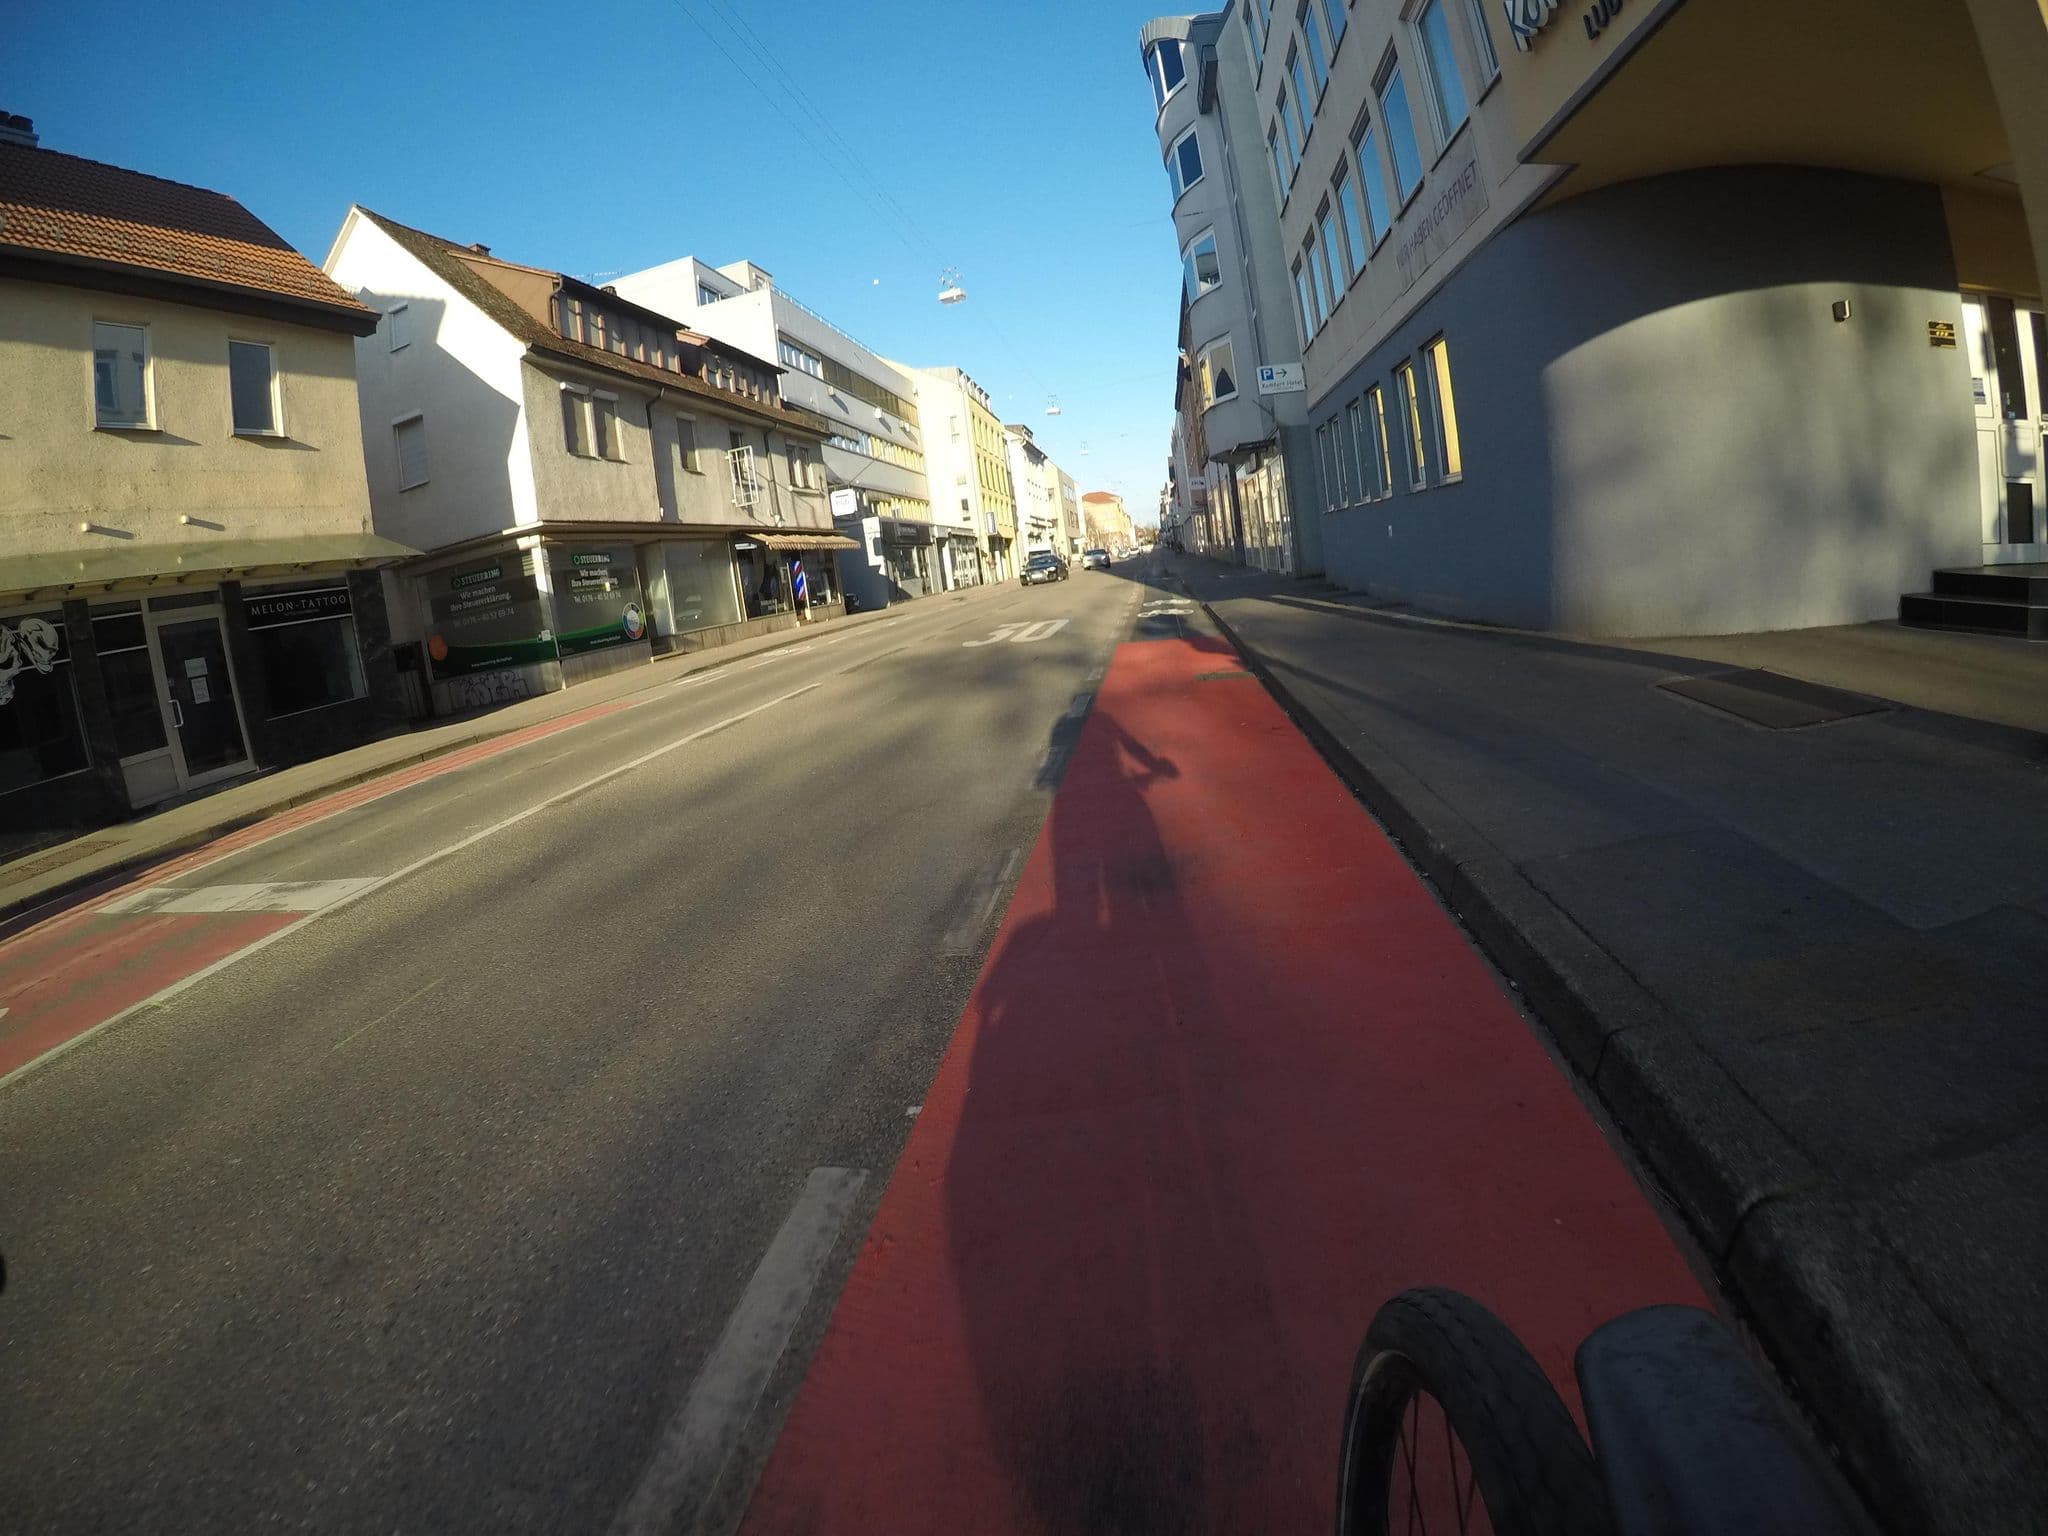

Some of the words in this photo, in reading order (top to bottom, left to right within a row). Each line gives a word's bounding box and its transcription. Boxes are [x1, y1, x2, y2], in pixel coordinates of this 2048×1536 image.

[1409, 215, 1434, 255] HABEN
[1433, 160, 1476, 226] GEÖFFNET
[1263, 369, 1271, 380] P
[461, 568, 501, 586] STEUERRING
[460, 590, 471, 600] Wir
[472, 585, 497, 597] machen
[251, 594, 346, 616] MELON-TATTOO
[962, 619, 1070, 648] 30
